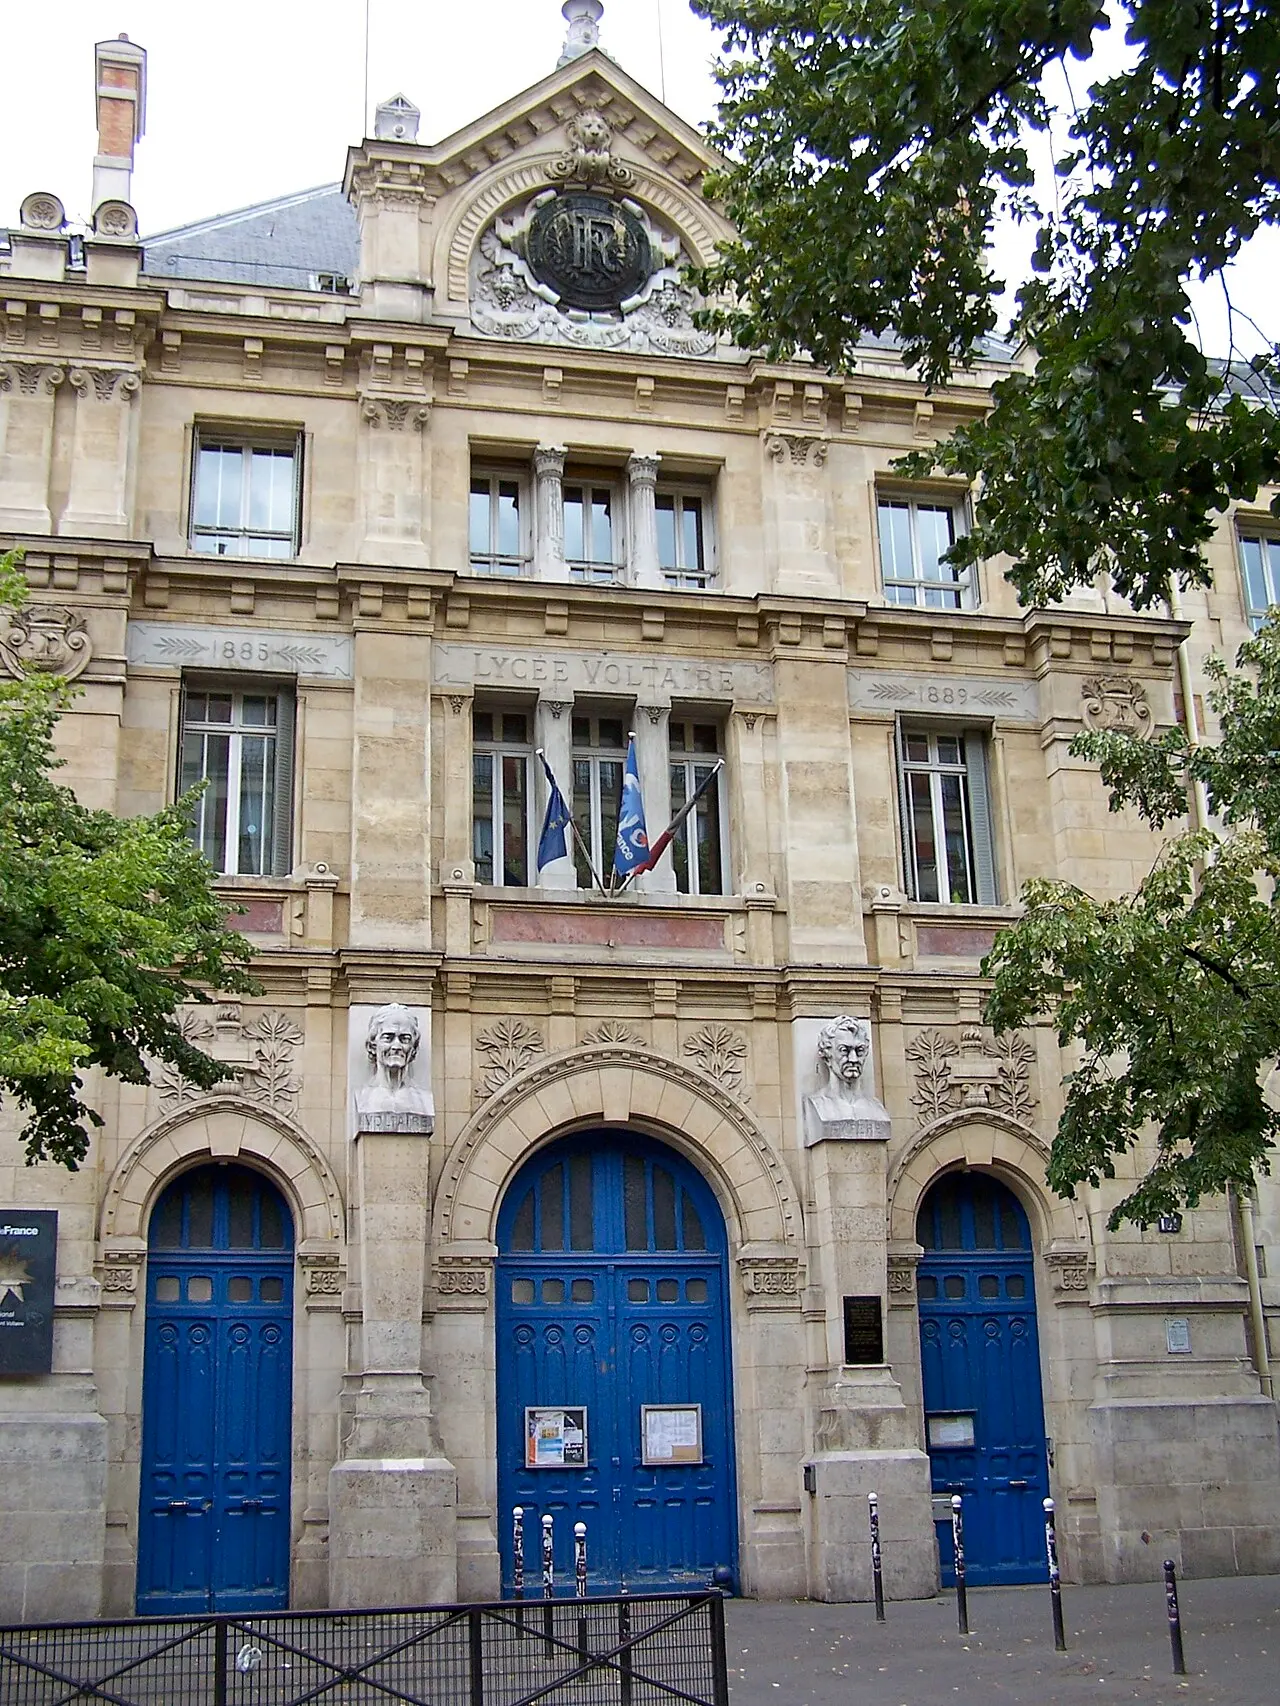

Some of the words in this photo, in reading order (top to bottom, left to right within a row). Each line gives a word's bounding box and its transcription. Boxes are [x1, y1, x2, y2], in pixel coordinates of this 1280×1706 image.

[212, 639, 269, 661] 1885
[473, 651, 568, 682] LYCÉE
[582, 659, 735, 692] VOLTAIRE
[918, 684, 968, 705] 1889
[616, 833, 634, 861] ance
[364, 1114, 428, 1128] VOLTAIRE
